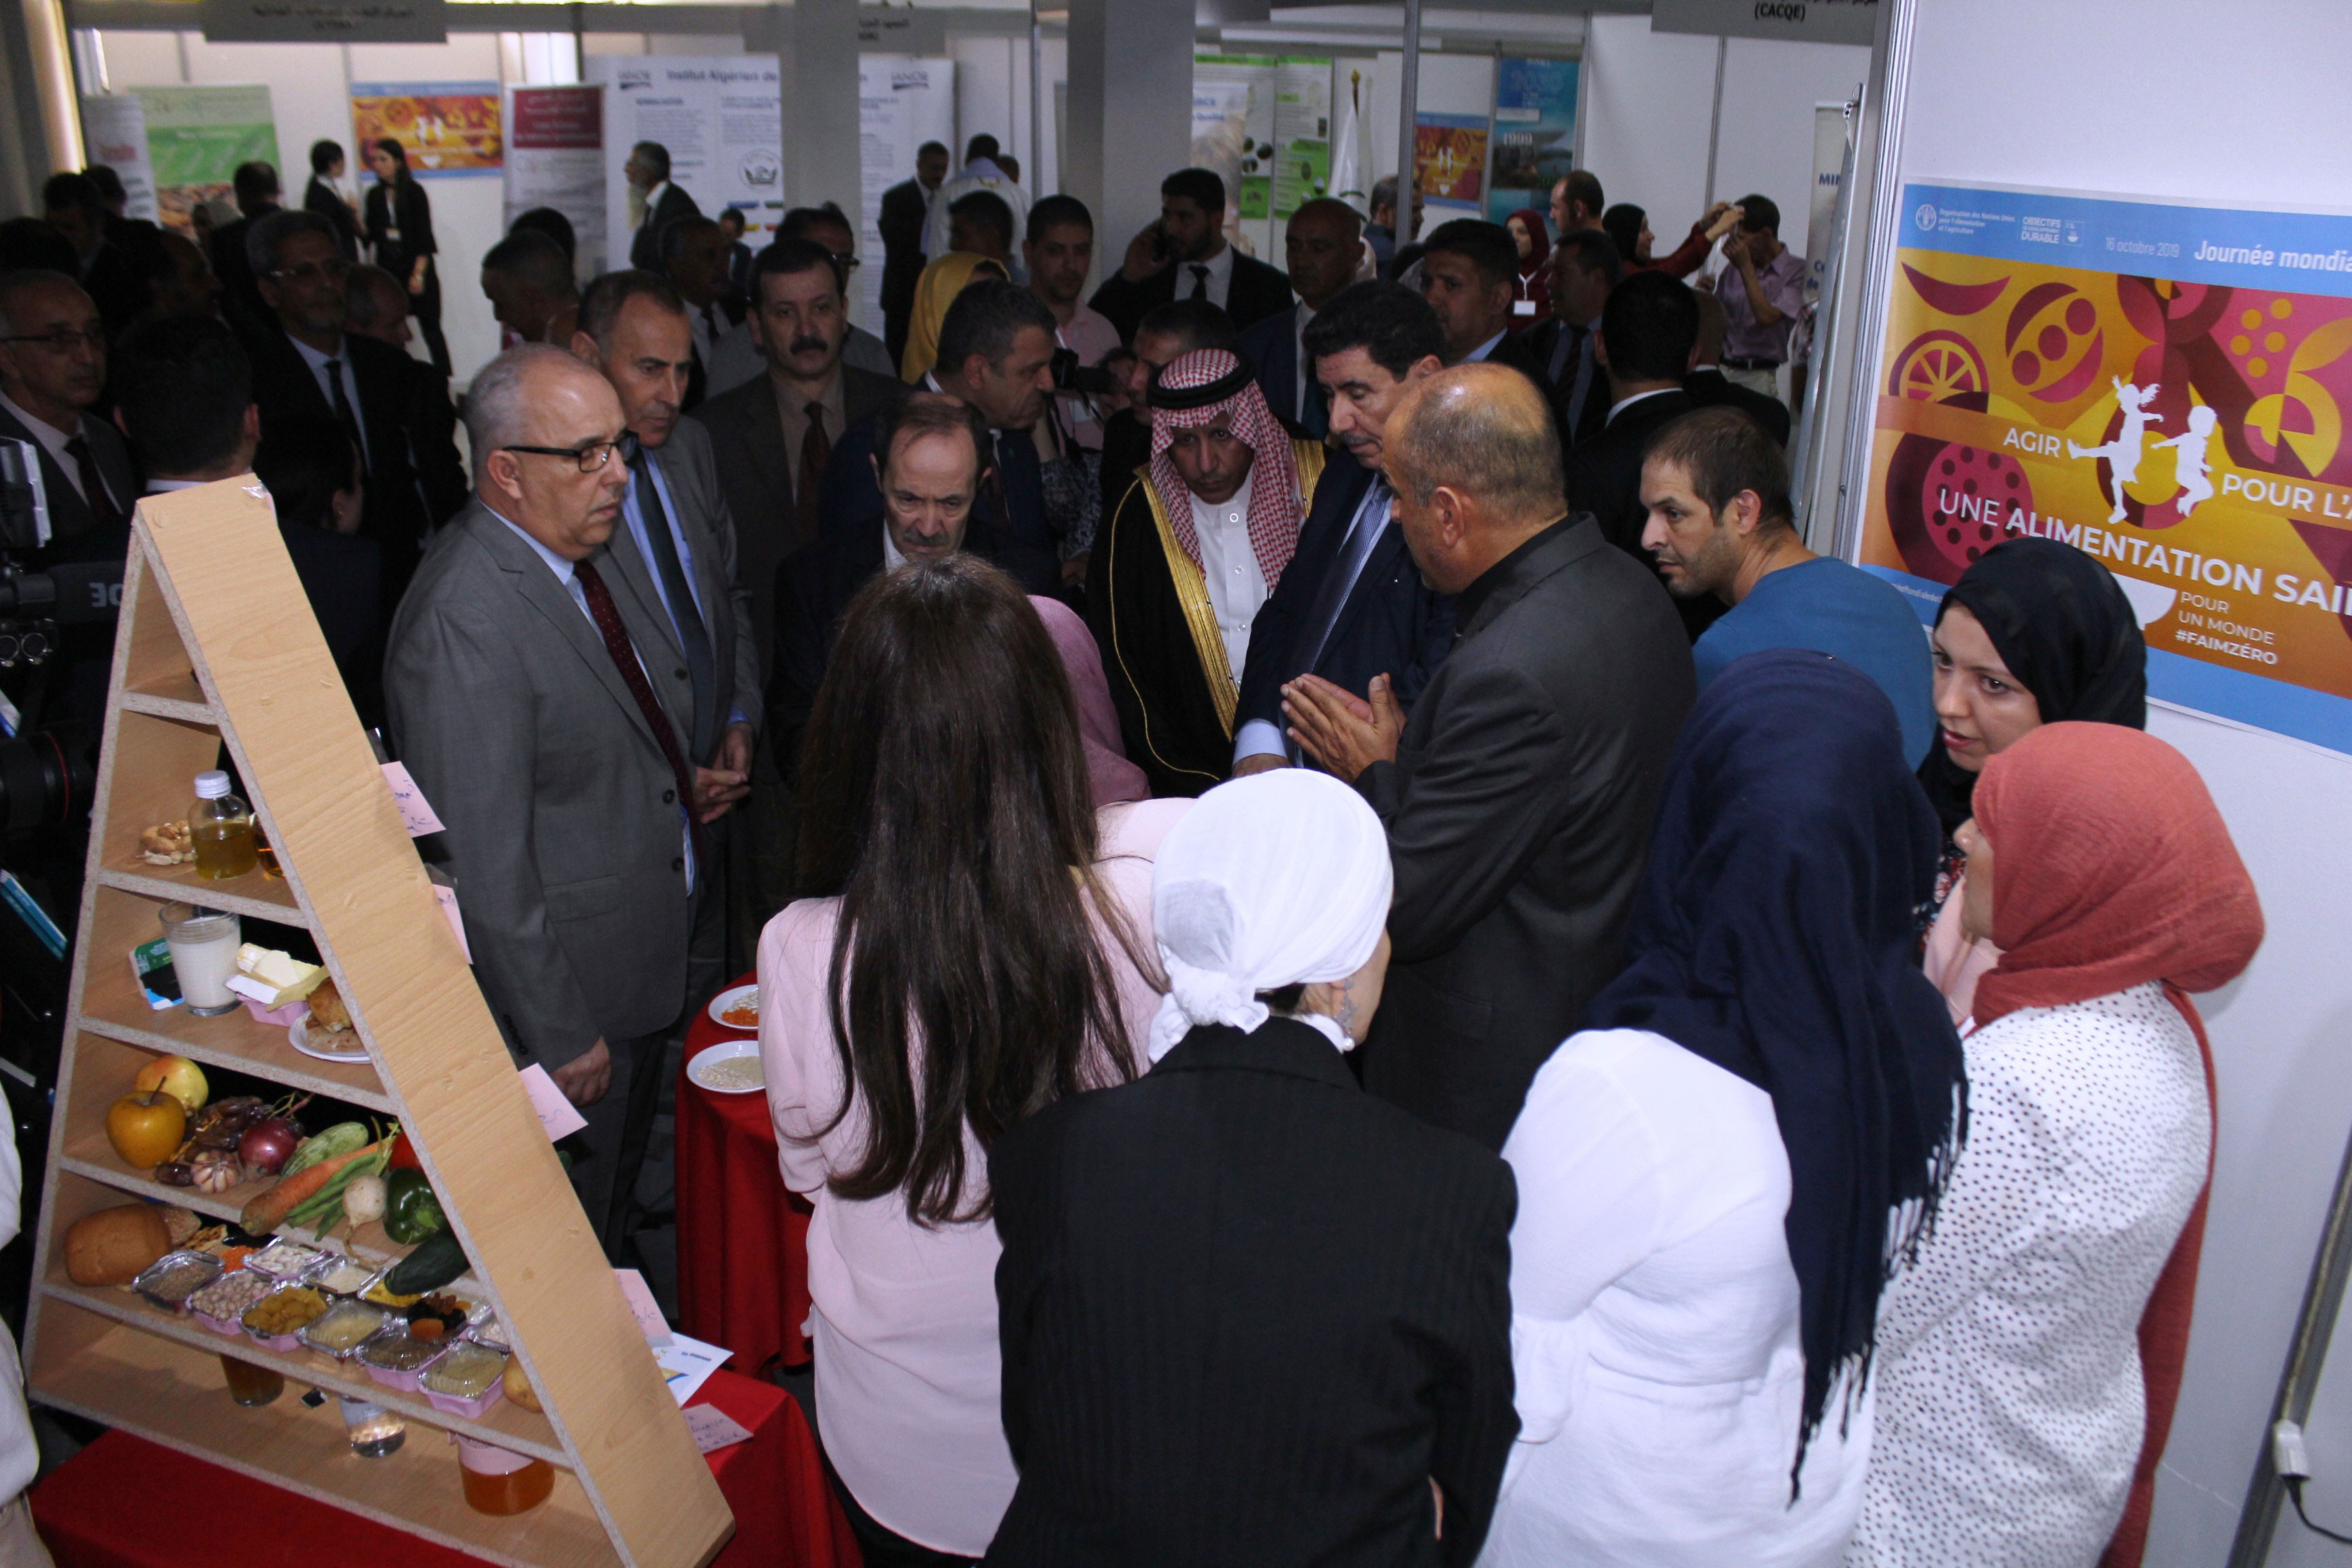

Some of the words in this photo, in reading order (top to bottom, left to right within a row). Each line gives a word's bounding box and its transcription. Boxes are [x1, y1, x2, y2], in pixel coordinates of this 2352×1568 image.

[1754, 3, 1806, 21] (CACQE)
[2023, 216, 2061, 228] OBJECTIFS
[2021, 231, 2059, 244] DURABLE
[2106, 237, 2115, 250] 16
[2117, 241, 2155, 255] octobre
[2157, 242, 2179, 257] 2019
[2194, 240, 2275, 266] Journée
[2003, 427, 2061, 458] AGIR
[2221, 473, 2315, 512] POUR
[2323, 493, 2352, 520] L'
[1940, 489, 2001, 527] UNE
[2005, 508, 2263, 595] ALIMENTATION
[2272, 573, 2352, 616] SAI
[2180, 591, 2230, 614] POUR
[2178, 610, 2204, 627] UN
[2207, 617, 2276, 645] MONDE
[2175, 630, 2278, 665] #FAIMZÉRO
